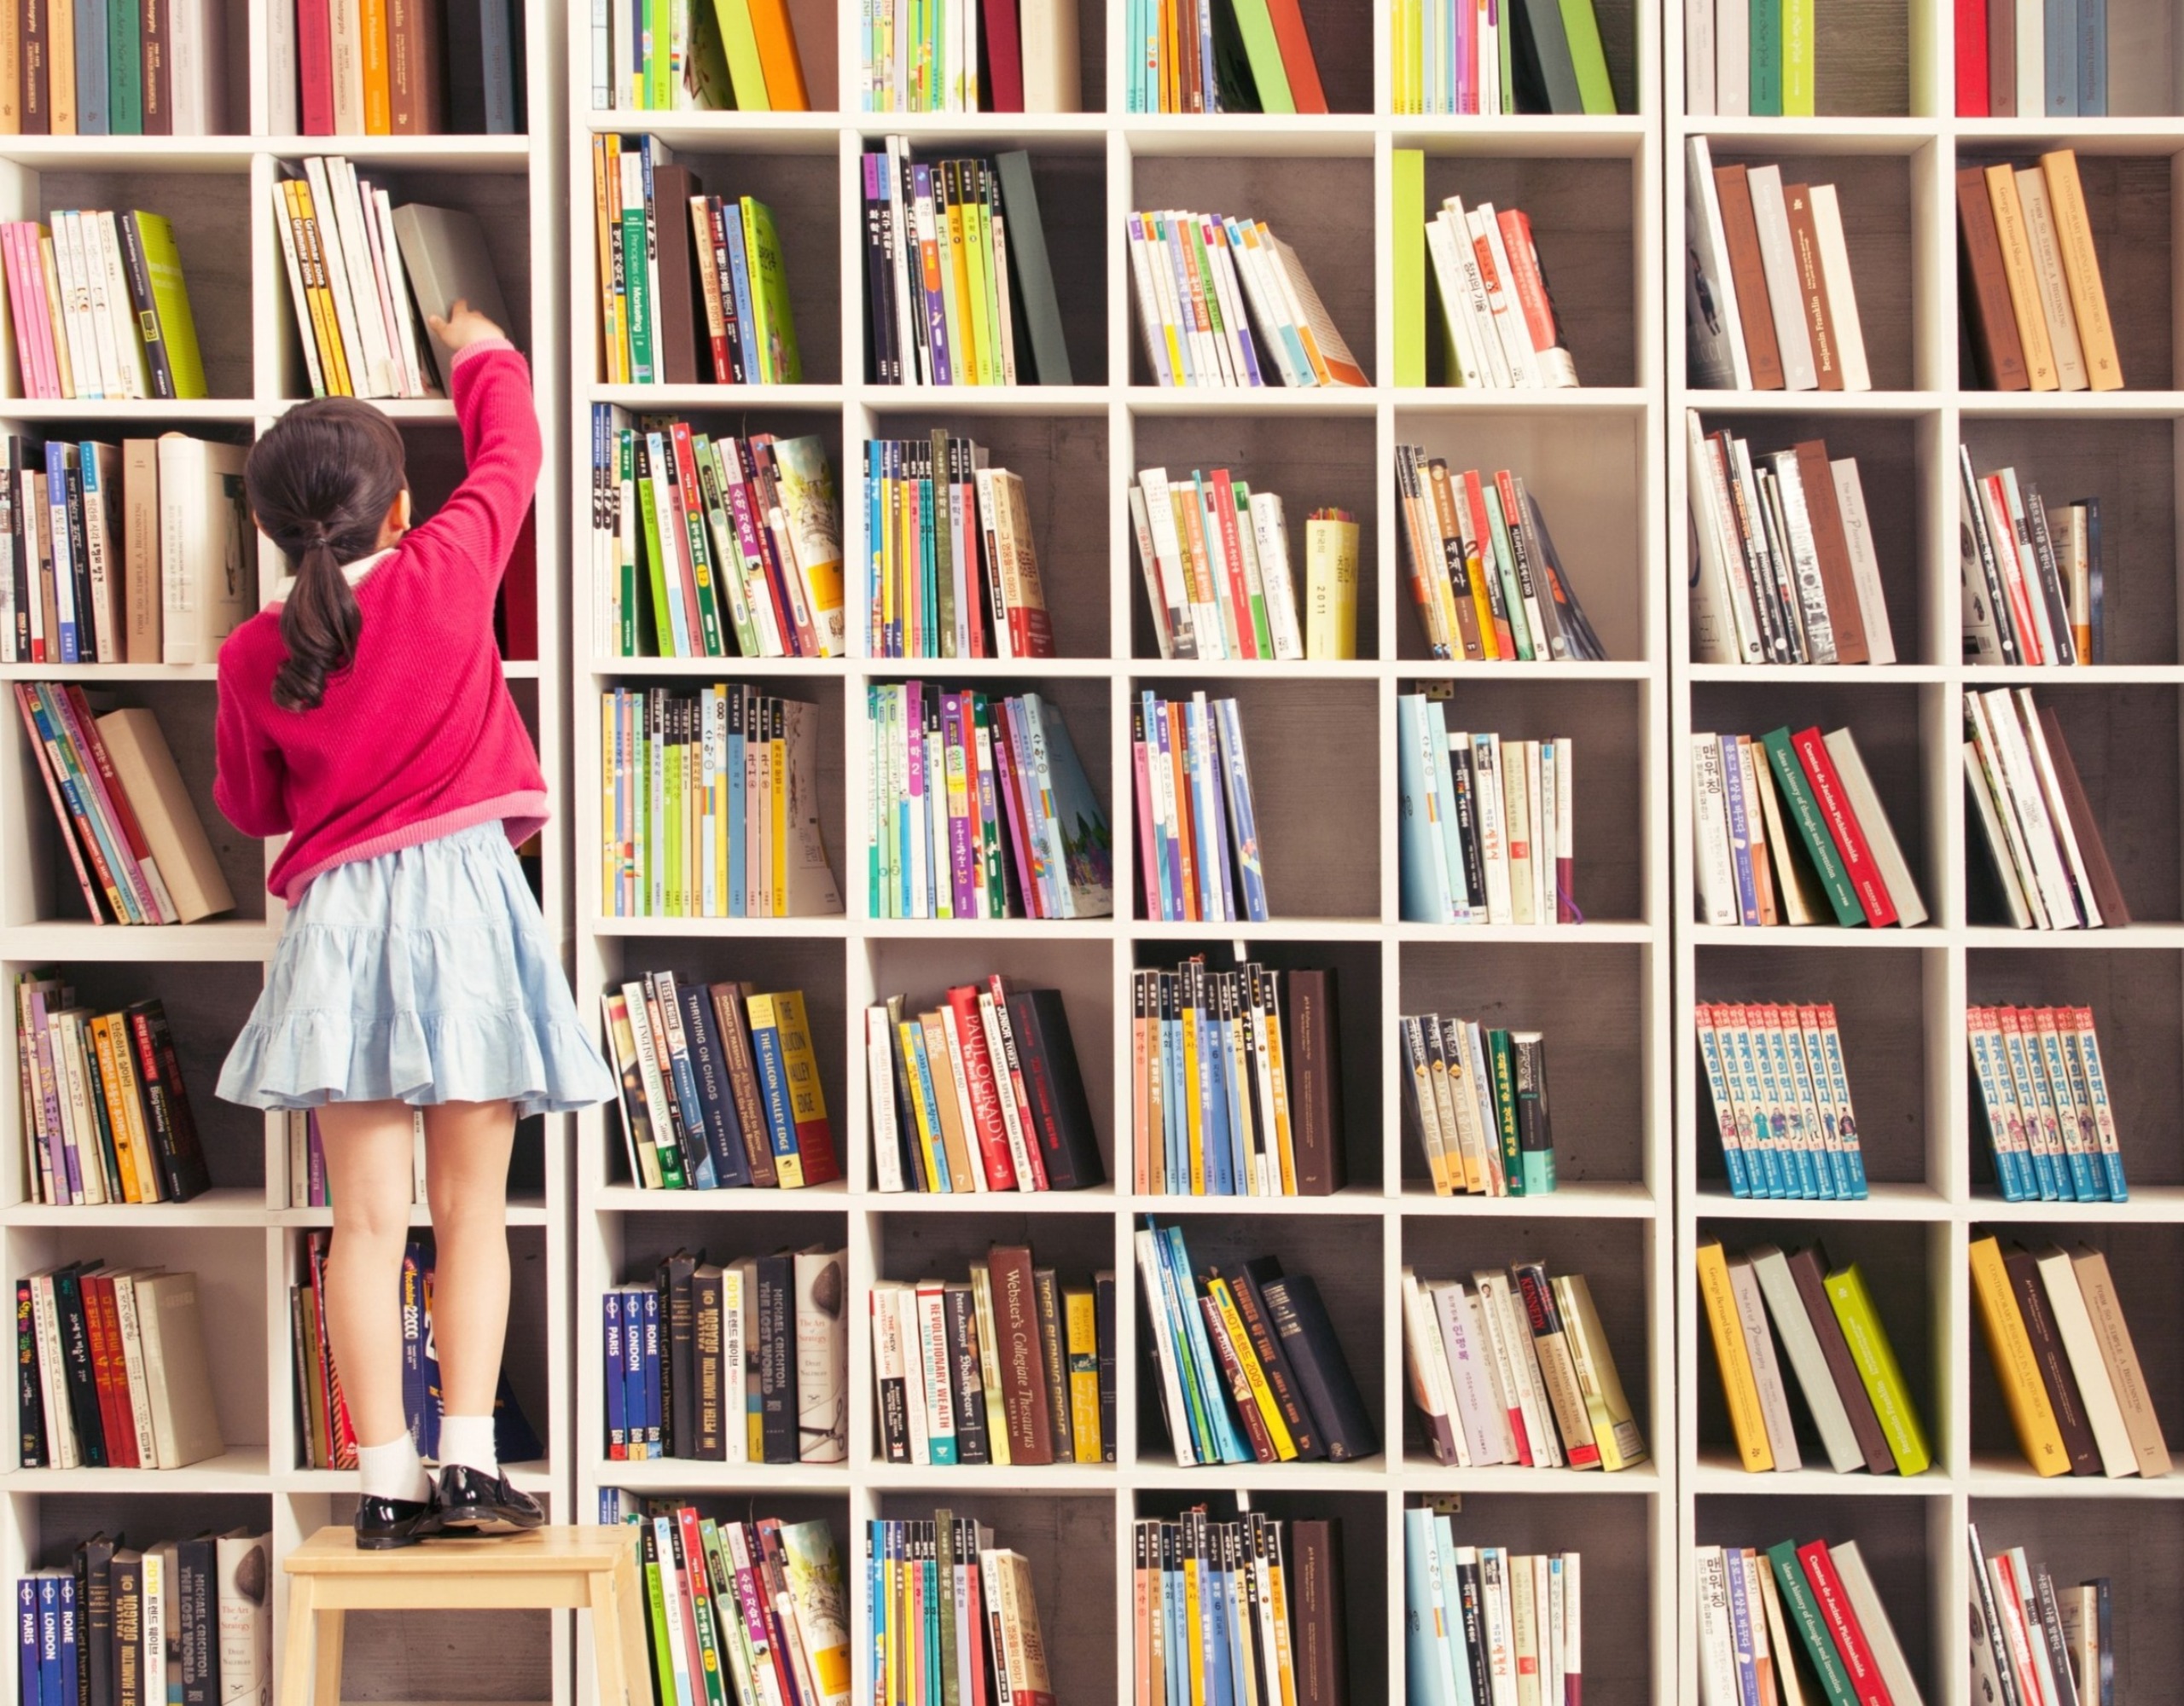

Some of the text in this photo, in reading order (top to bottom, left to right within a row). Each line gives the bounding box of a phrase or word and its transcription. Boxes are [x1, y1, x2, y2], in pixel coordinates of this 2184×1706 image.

[1999, 187, 2023, 267] George Bernard Shaw
[293, 218, 314, 286] Grammar zone
[305, 218, 326, 287] Grammar zone
[630, 234, 641, 272] Principles
[633, 287, 644, 333] Marketing
[706, 271, 722, 331] 영웅들의 이야기
[146, 328, 156, 339] 23
[1811, 296, 1832, 372] Benjamin Franklin
[1842, 481, 1854, 508] The Art
[134, 502, 143, 550] BEGINNING
[56, 537, 69, 561] CS5
[1001, 542, 1015, 571] 영웅들의
[1445, 541, 1467, 589] 세계사
[1005, 572, 1018, 602] 이야기
[1316, 585, 1326, 615] 2011
[1523, 582, 1532, 596] 100
[1803, 741, 1837, 811] Cuentos Jacinta
[1786, 771, 1837, 878] history and invention
[661, 980, 679, 1030] TEST ENGINE
[721, 995, 734, 1028] DONALD
[996, 1007, 1012, 1039] JUNIOR
[111, 1021, 126, 1058] 단순하게
[638, 1025, 654, 1063] ENGLISH
[668, 1030, 689, 1061] SAT
[688, 994, 718, 1101] THRIVING ON CHAOS
[761, 1032, 790, 1152] THE SILICON VALLEY EDGE
[965, 1014, 1006, 1144] PAUL O'GRADY
[149, 1086, 165, 1133] Blog Marketing
[714, 1111, 729, 1158] TOM PETERS
[404, 1269, 418, 1307] Vocabulary
[727, 1274, 739, 1309] 2010
[1520, 1277, 1545, 1330] KENNEDY
[1709, 1267, 1730, 1327] George Bernard
[1740, 1288, 1750, 1303] The
[404, 1306, 418, 1340] 22000
[608, 1326, 619, 1356] PARIS
[647, 1324, 657, 1355] ROME
[705, 1309, 719, 1353] DRAGON
[774, 1289, 787, 1389] MICHAEL CRICHTON
[799, 1318, 827, 1328] The Art
[1252, 1323, 1276, 1362] OF TIME
[2107, 1323, 2123, 1354] SIMPLE
[629, 1326, 639, 1372] LONDON
[762, 1312, 775, 1396] LOST WORLD
[931, 1303, 950, 1430] REVOLUTIONARY WEALTH
[1007, 1269, 1034, 1449] Webster's Collegiate Thesaurus
[1224, 1309, 1263, 1388] HOT 2009
[703, 1357, 717, 1434] PETER HAMILTON
[1009, 1397, 1019, 1436] MERRIAM
[146, 1560, 159, 1596] 2010
[1809, 1555, 1843, 1625] Cuentos Jacinta
[24, 1613, 35, 1645] PARIS
[63, 1610, 74, 1643] ROME
[124, 1595, 138, 1641] DRAGON
[195, 1574, 207, 1678] MICHAEL CRICHTON
[222, 1605, 235, 1616] The
[44, 1612, 55, 1660] LONDON
[182, 1599, 195, 1684] LOST WORLD
[1007, 1626, 1021, 1655] 영웅들의
[1792, 1585, 1842, 1693] history and invention
[122, 1645, 136, 1686] HAMILTON
[1010, 1656, 1024, 1686] 이야기
